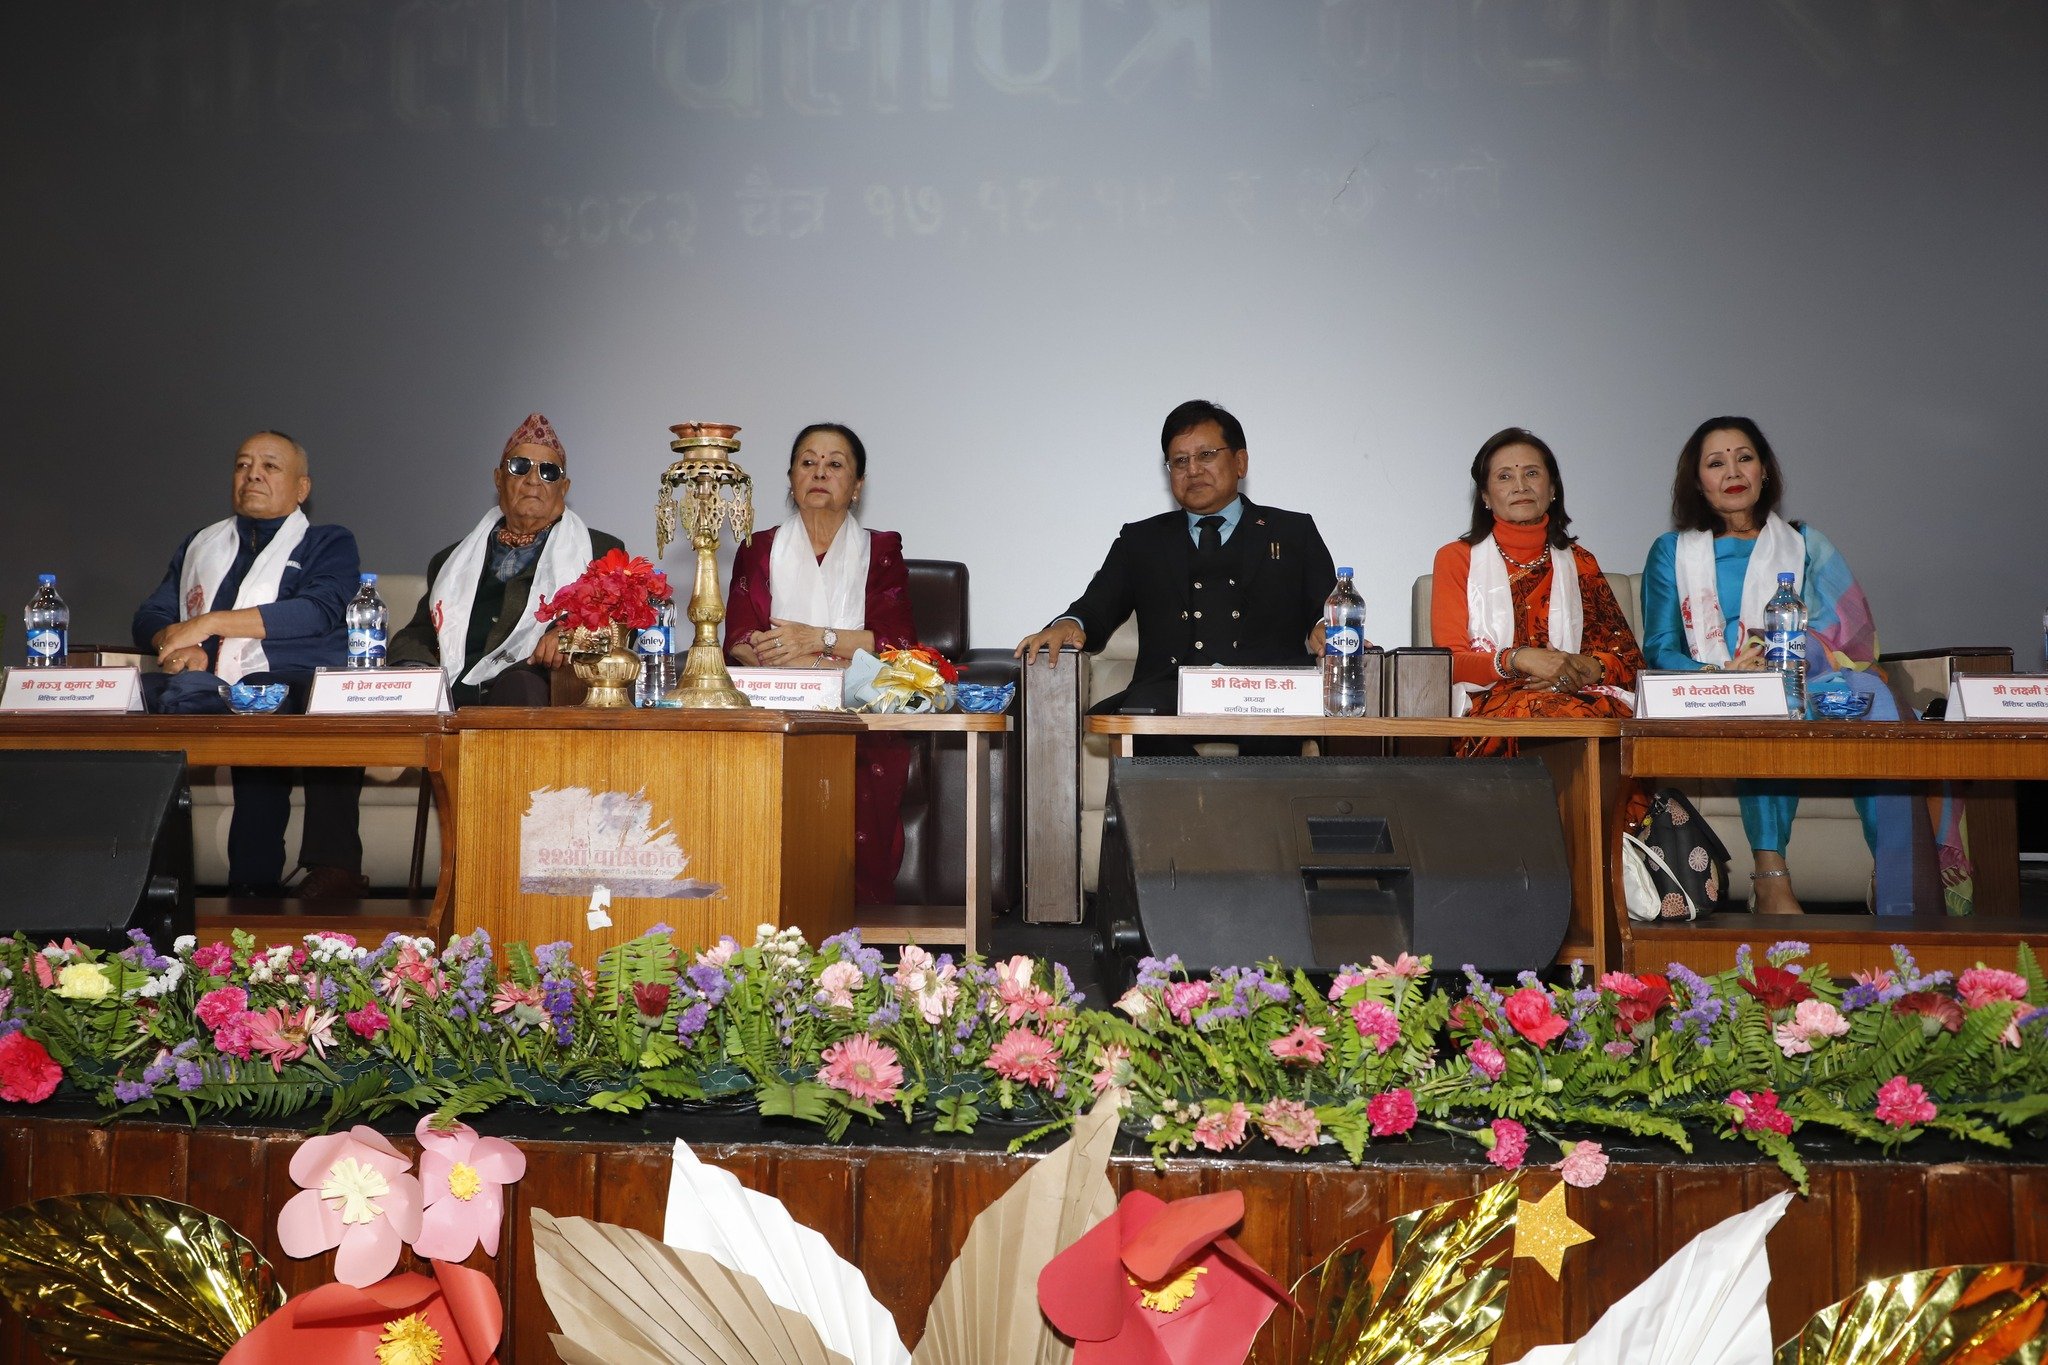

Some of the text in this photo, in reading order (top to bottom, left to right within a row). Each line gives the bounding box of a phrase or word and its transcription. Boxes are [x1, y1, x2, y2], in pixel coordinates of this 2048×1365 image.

[640, 636, 663, 647] kinley
[21, 680, 34, 690] श्री
[64, 681, 92, 691] कुमार
[341, 680, 354, 691] श्री
[357, 680, 373, 690] प्रेम
[748, 681, 771, 691] भुवन
[774, 681, 797, 690] थापा
[800, 682, 822, 691] चन्द
[1211, 677, 1225, 688] श्री
[1229, 677, 1261, 690] दिनेश
[1672, 685, 1685, 696] श्री
[1734, 684, 1755, 695] सिंह
[1993, 685, 2006, 695] श्री
[2010, 685, 2041, 695] लक्ष्मी
